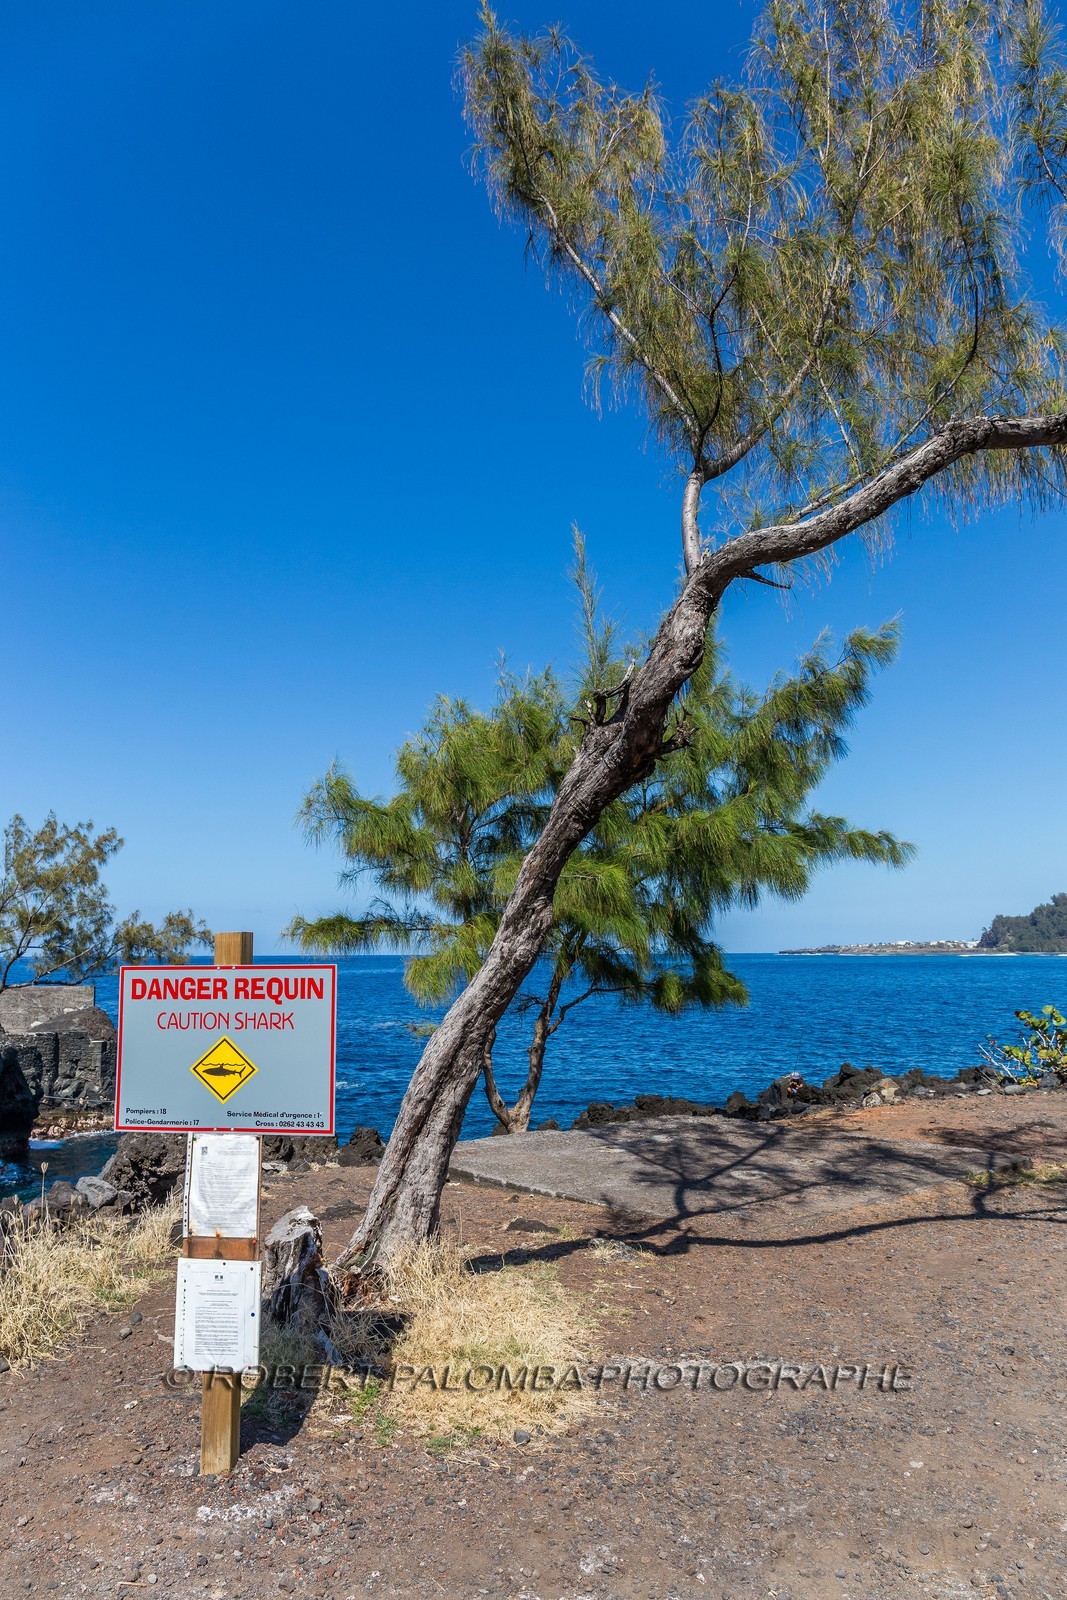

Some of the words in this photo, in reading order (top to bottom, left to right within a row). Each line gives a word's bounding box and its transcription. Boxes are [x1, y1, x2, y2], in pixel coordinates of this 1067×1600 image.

[131, 977, 228, 1000] DANGER
[234, 977, 324, 1005] REQUIN
[156, 1011, 230, 1030] CAUTION
[234, 1011, 295, 1030] SHARK
[126, 1107, 155, 1115] Pompiers
[226, 1110, 252, 1118] Service
[125, 1118, 188, 1126] Police-Gendarmerie
[278, 1120, 295, 1128] 0262
